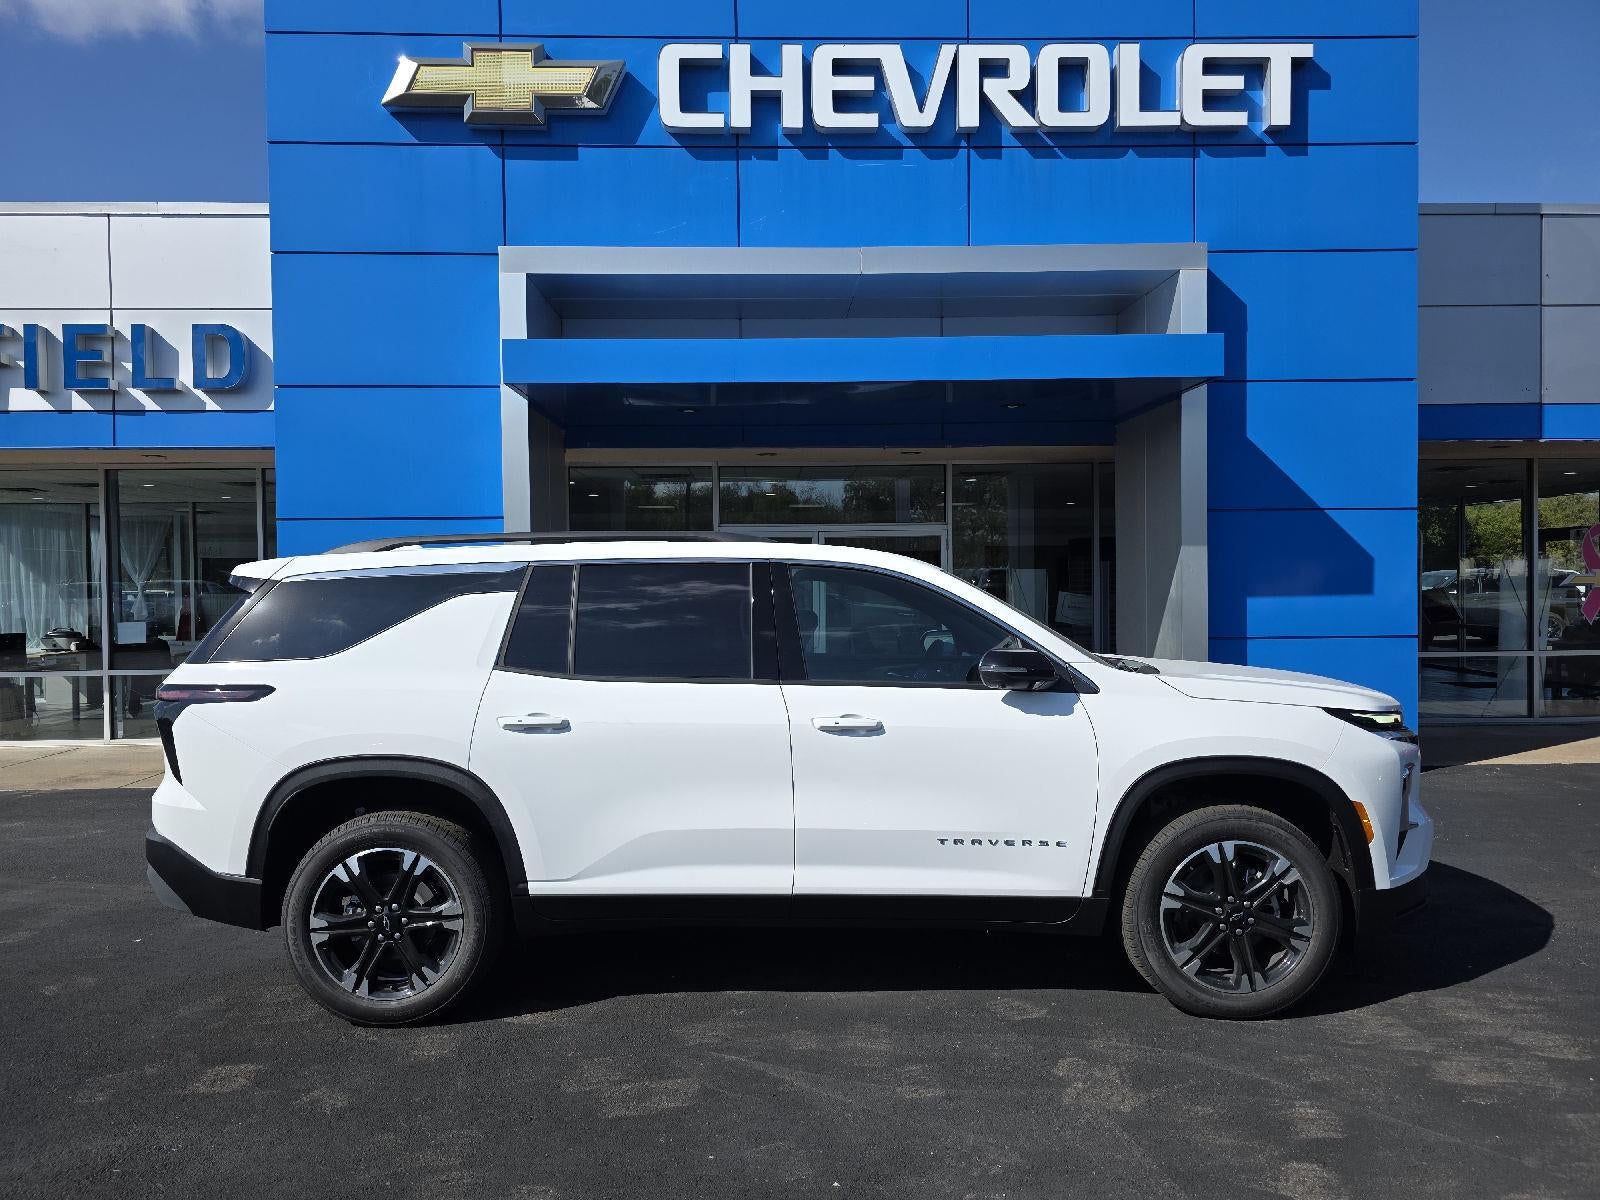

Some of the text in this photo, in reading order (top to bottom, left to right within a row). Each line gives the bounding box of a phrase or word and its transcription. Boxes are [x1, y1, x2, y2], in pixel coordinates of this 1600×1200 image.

[657, 42, 1314, 132] CHEVROLET
[0, 323, 247, 391] IELD
[936, 838, 1068, 848] TRAVERSE
